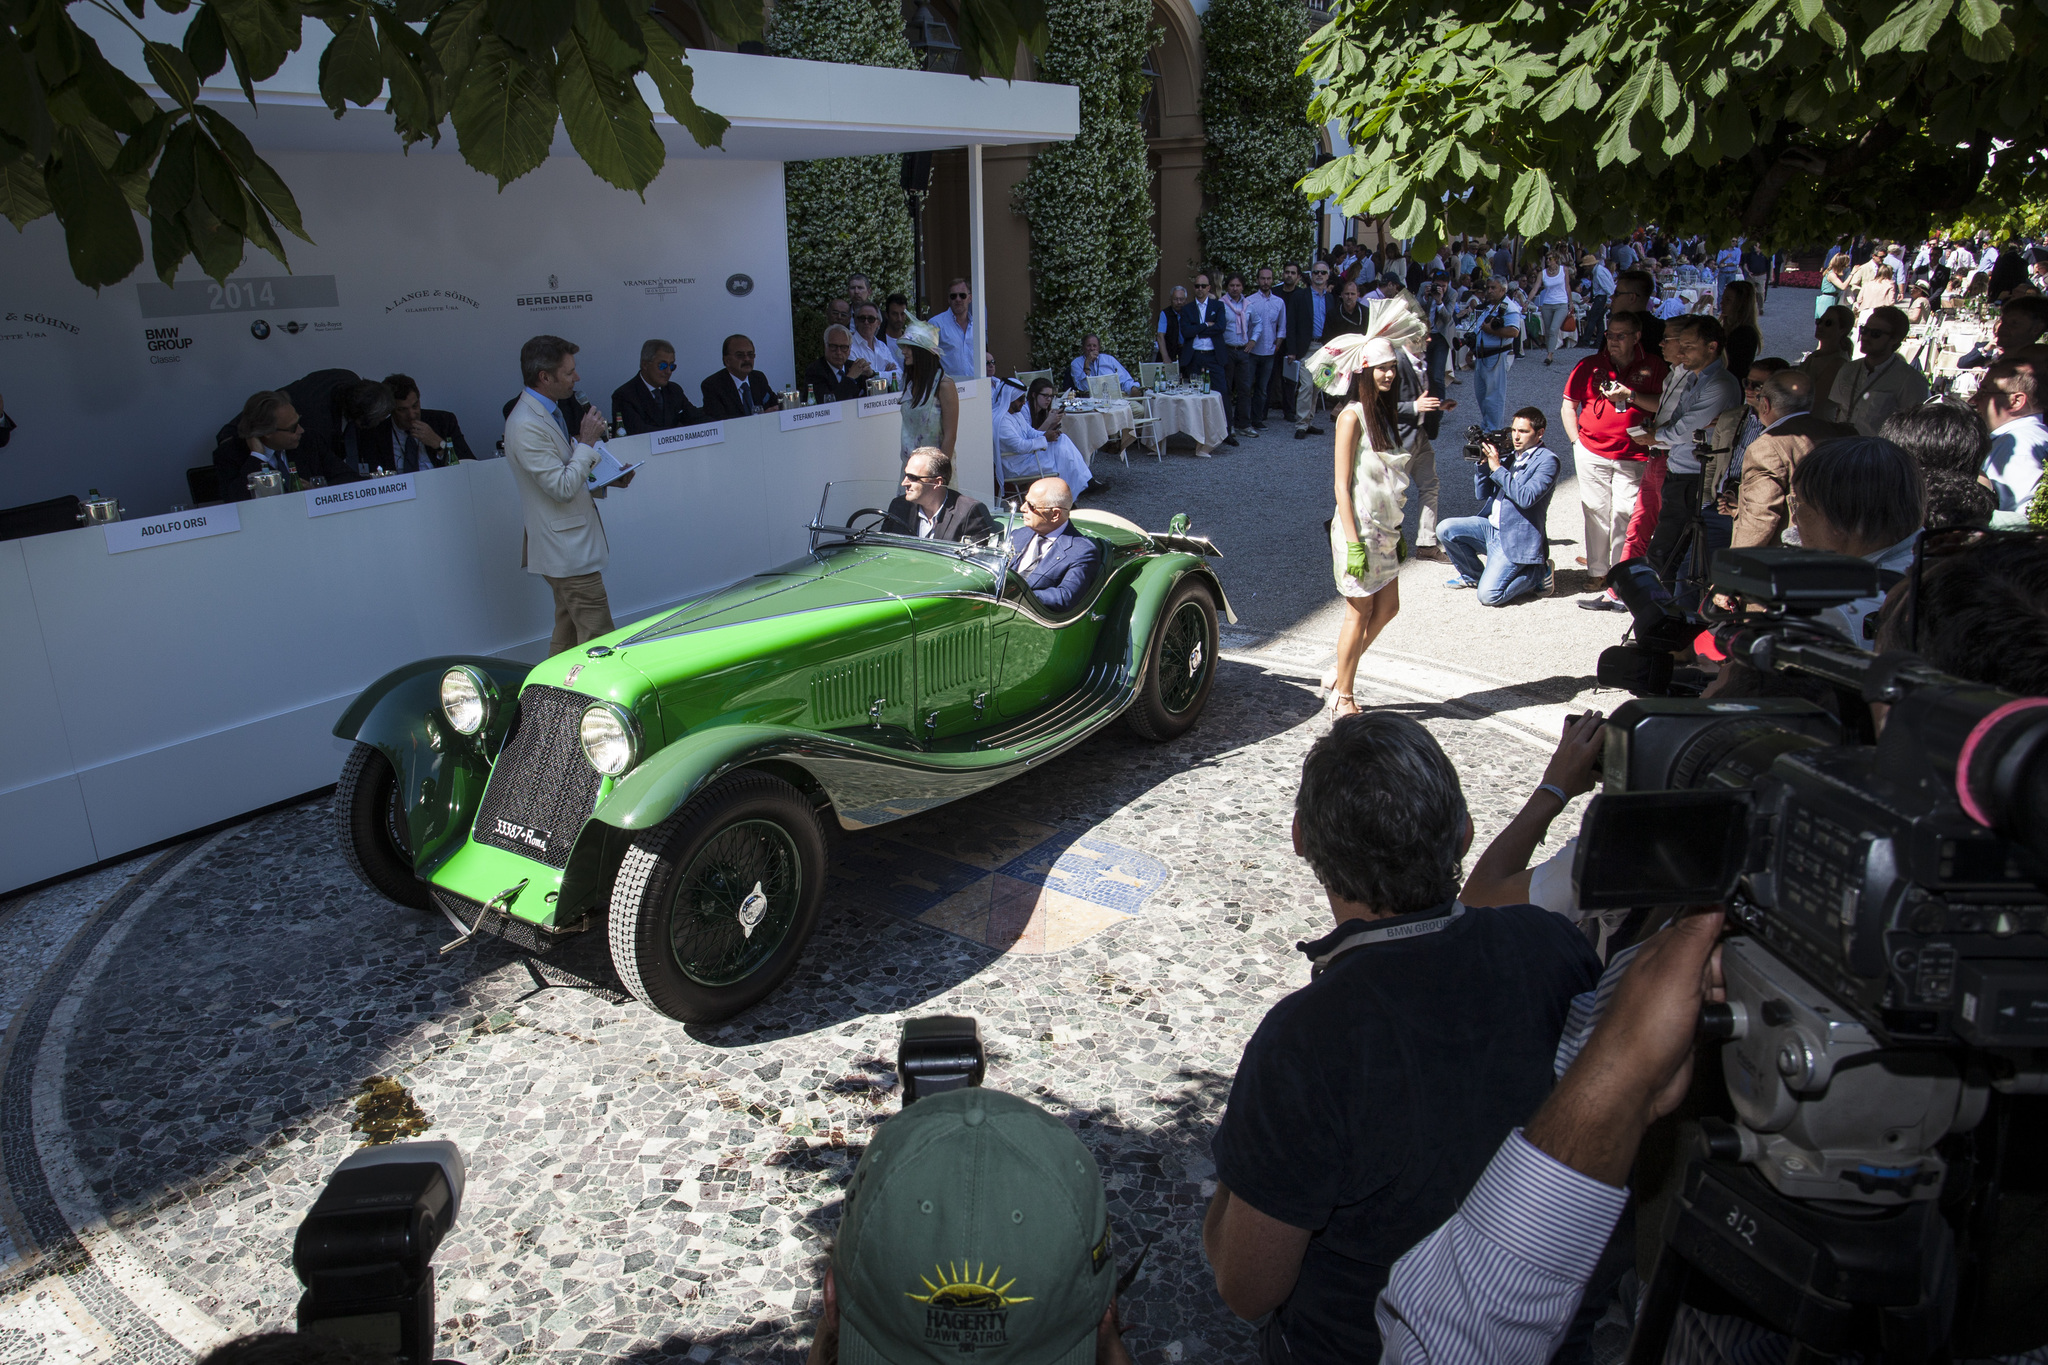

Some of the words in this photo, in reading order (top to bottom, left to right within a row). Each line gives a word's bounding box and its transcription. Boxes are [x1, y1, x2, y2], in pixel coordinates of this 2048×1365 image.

[623, 279, 658, 287] VRANKEN
[207, 282, 276, 310] 2014
[445, 290, 480, 309] SÖHNE
[517, 294, 593, 306] BERENBERG
[5, 312, 18, 321] &
[24, 312, 80, 335] SÖHNE
[145, 328, 179, 340] BMW
[148, 338, 193, 352] GROUP
[150, 354, 181, 365] Classic
[863, 401, 882, 410] PATRICK
[882, 399, 888, 407] LE
[792, 411, 815, 422] STEFANO
[814, 408, 831, 419] PASINI
[657, 434, 684, 446] LORENZO
[684, 428, 719, 442] RAMACIOTTI
[315, 490, 355, 506] CHARLES
[355, 487, 378, 500] LORD
[378, 481, 408, 496] MARCH
[140, 519, 182, 537] ADOLFO
[182, 516, 208, 531] ORSI
[495, 819, 525, 840] 33387
[1386, 925, 1413, 938] BMW
[1414, 919, 1449, 933] GROUP
[926, 1309, 1009, 1331] HAGERTY
[925, 1327, 960, 1342] DAWN
[964, 1329, 1009, 1343] PATROL
